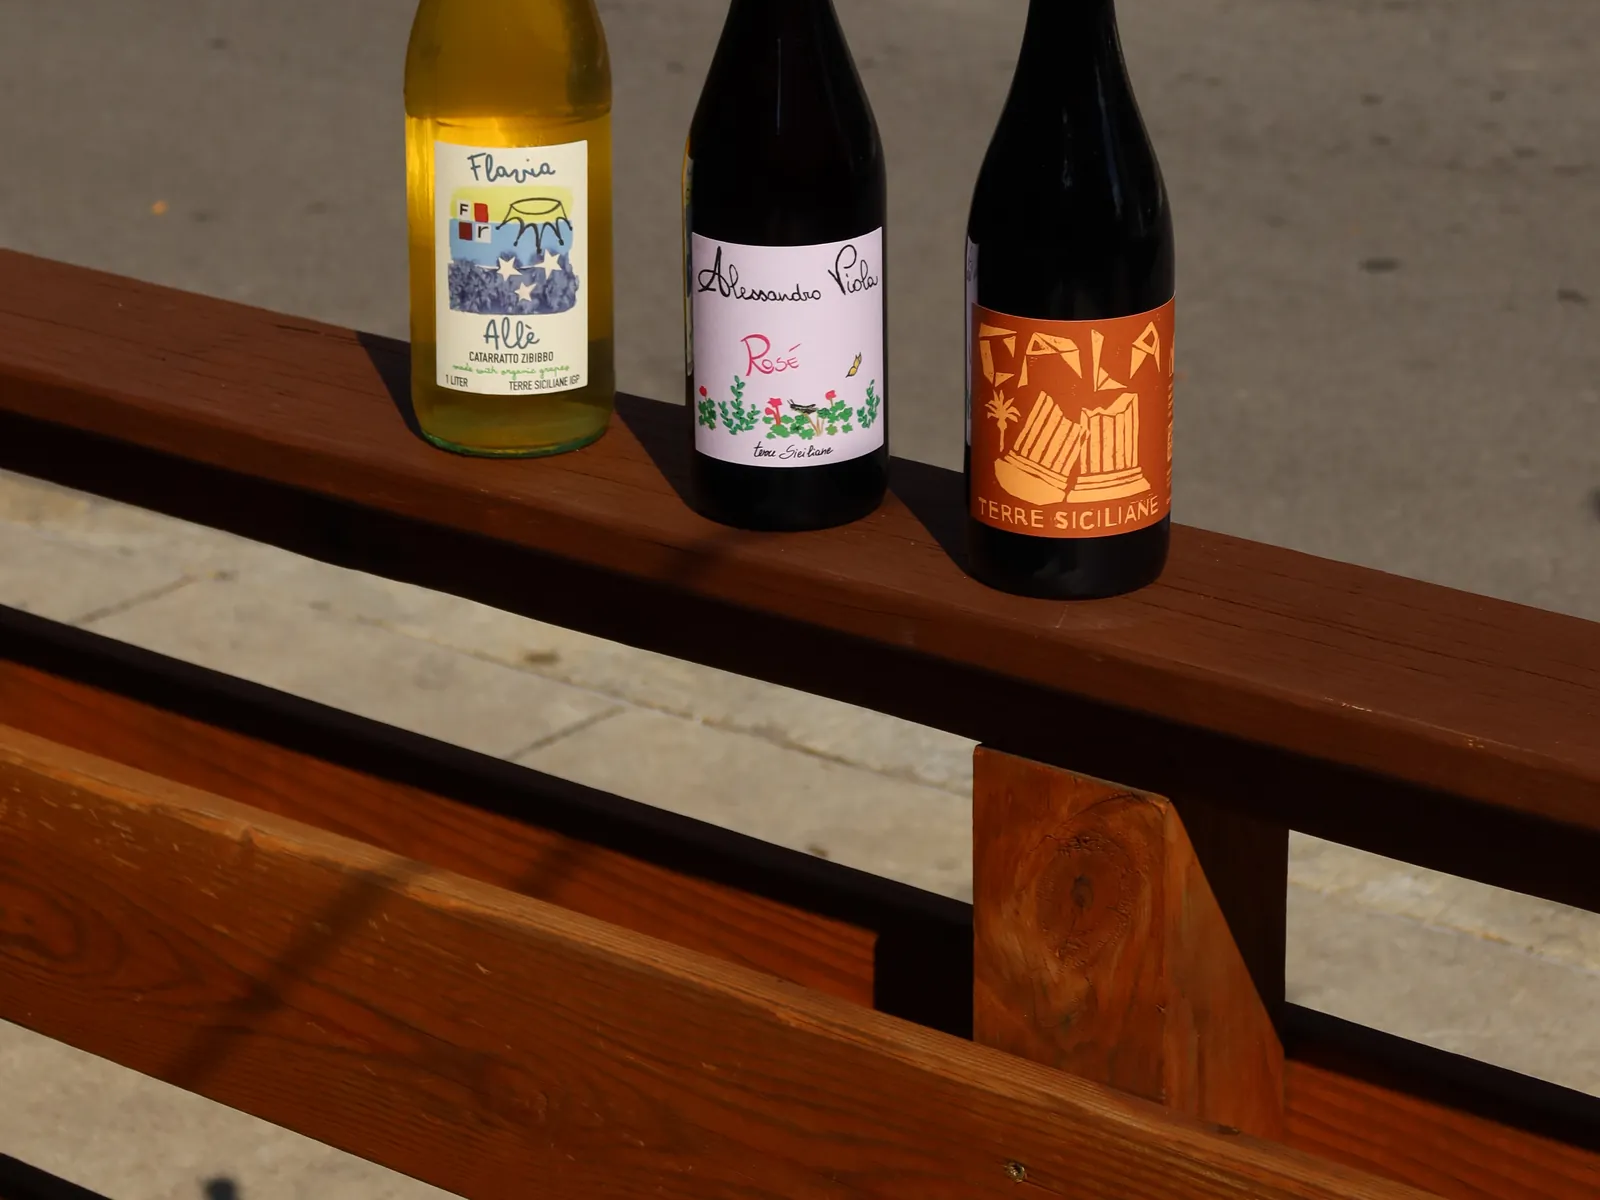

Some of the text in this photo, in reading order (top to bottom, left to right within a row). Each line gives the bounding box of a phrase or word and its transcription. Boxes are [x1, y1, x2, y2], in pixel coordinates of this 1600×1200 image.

[467, 153, 556, 183] Flavia
[460, 203, 469, 215] F
[698, 246, 821, 302] Alessandro
[483, 317, 540, 350] Allè
[469, 351, 554, 364] CATARRATTO ZIBIBBO
[978, 321, 1160, 392] CALA
[450, 375, 468, 387] LITER
[452, 363, 570, 380] made with organic grapes
[509, 374, 580, 391] TERRE SICILIANE IGP
[978, 495, 1159, 530] TERRE SICILIANE
